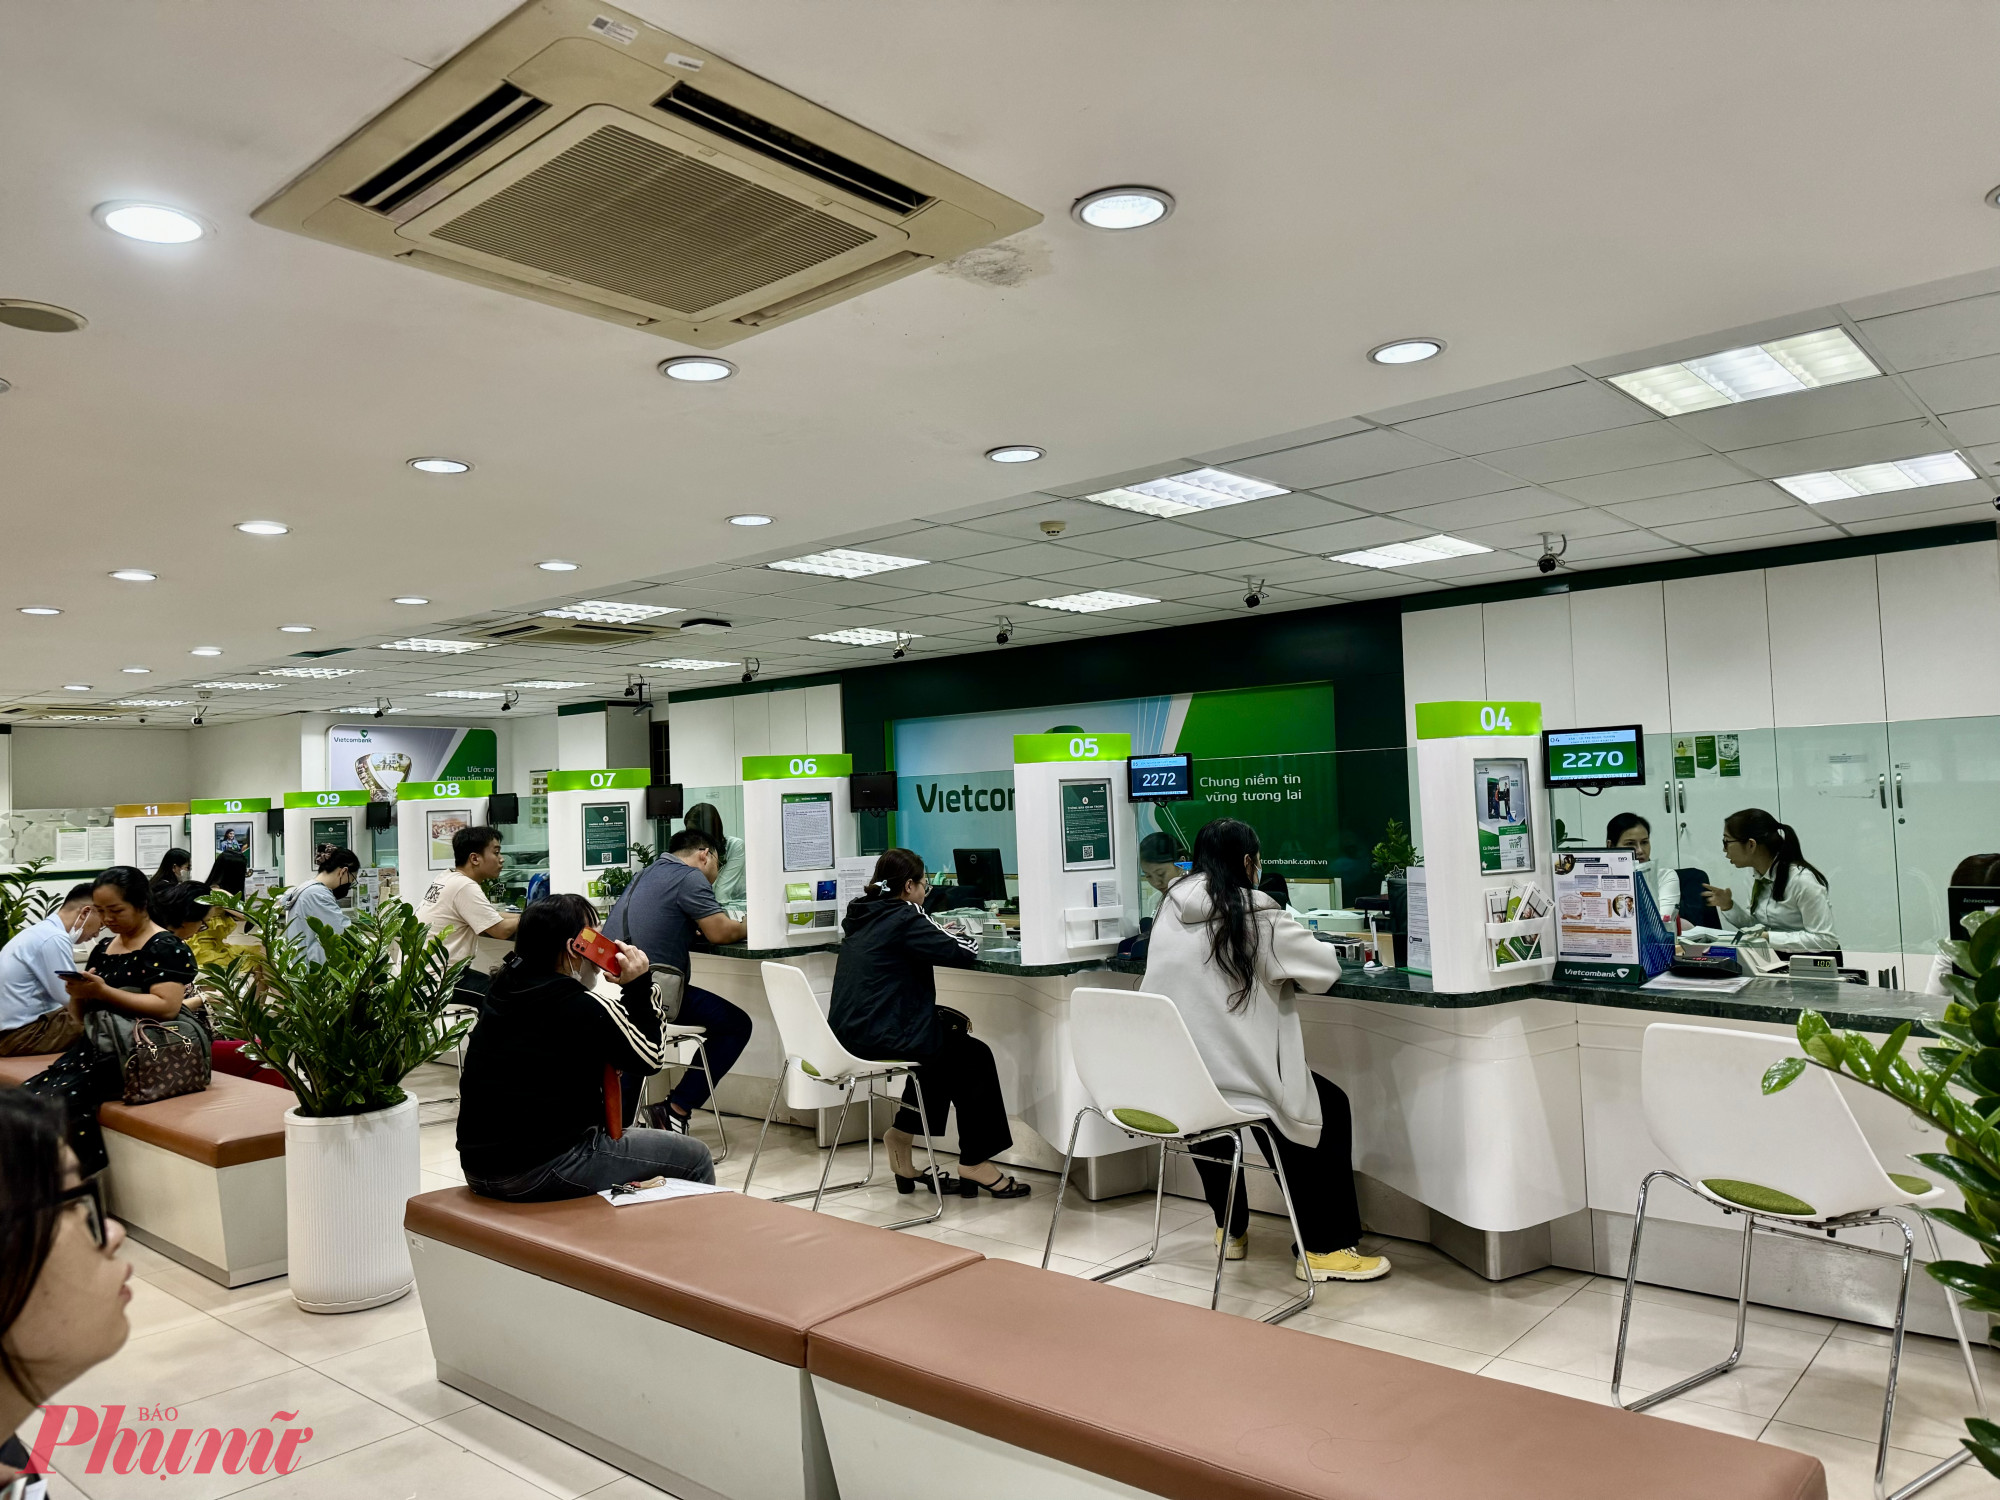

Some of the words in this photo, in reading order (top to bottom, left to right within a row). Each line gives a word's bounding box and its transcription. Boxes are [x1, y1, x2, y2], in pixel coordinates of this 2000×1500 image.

[1481, 706, 1512, 731] 04
[1069, 738, 1099, 758] 05
[789, 758, 817, 775] 06
[1562, 750, 1624, 768] 2270
[590, 772, 616, 787] 07
[1142, 772, 1177, 787] 2272
[1200, 777, 1240, 788] Chung
[1245, 773, 1278, 785] niềm
[1283, 773, 1301, 784] tin
[433, 782, 461, 797] 08
[1206, 792, 1237, 803] vững
[1242, 791, 1281, 802] tương
[1287, 789, 1302, 800] lai
[224, 801, 242, 812] 10
[316, 793, 340, 805] 09
[144, 805, 158, 815] 11
[1564, 968, 1617, 978] Vietcombank
